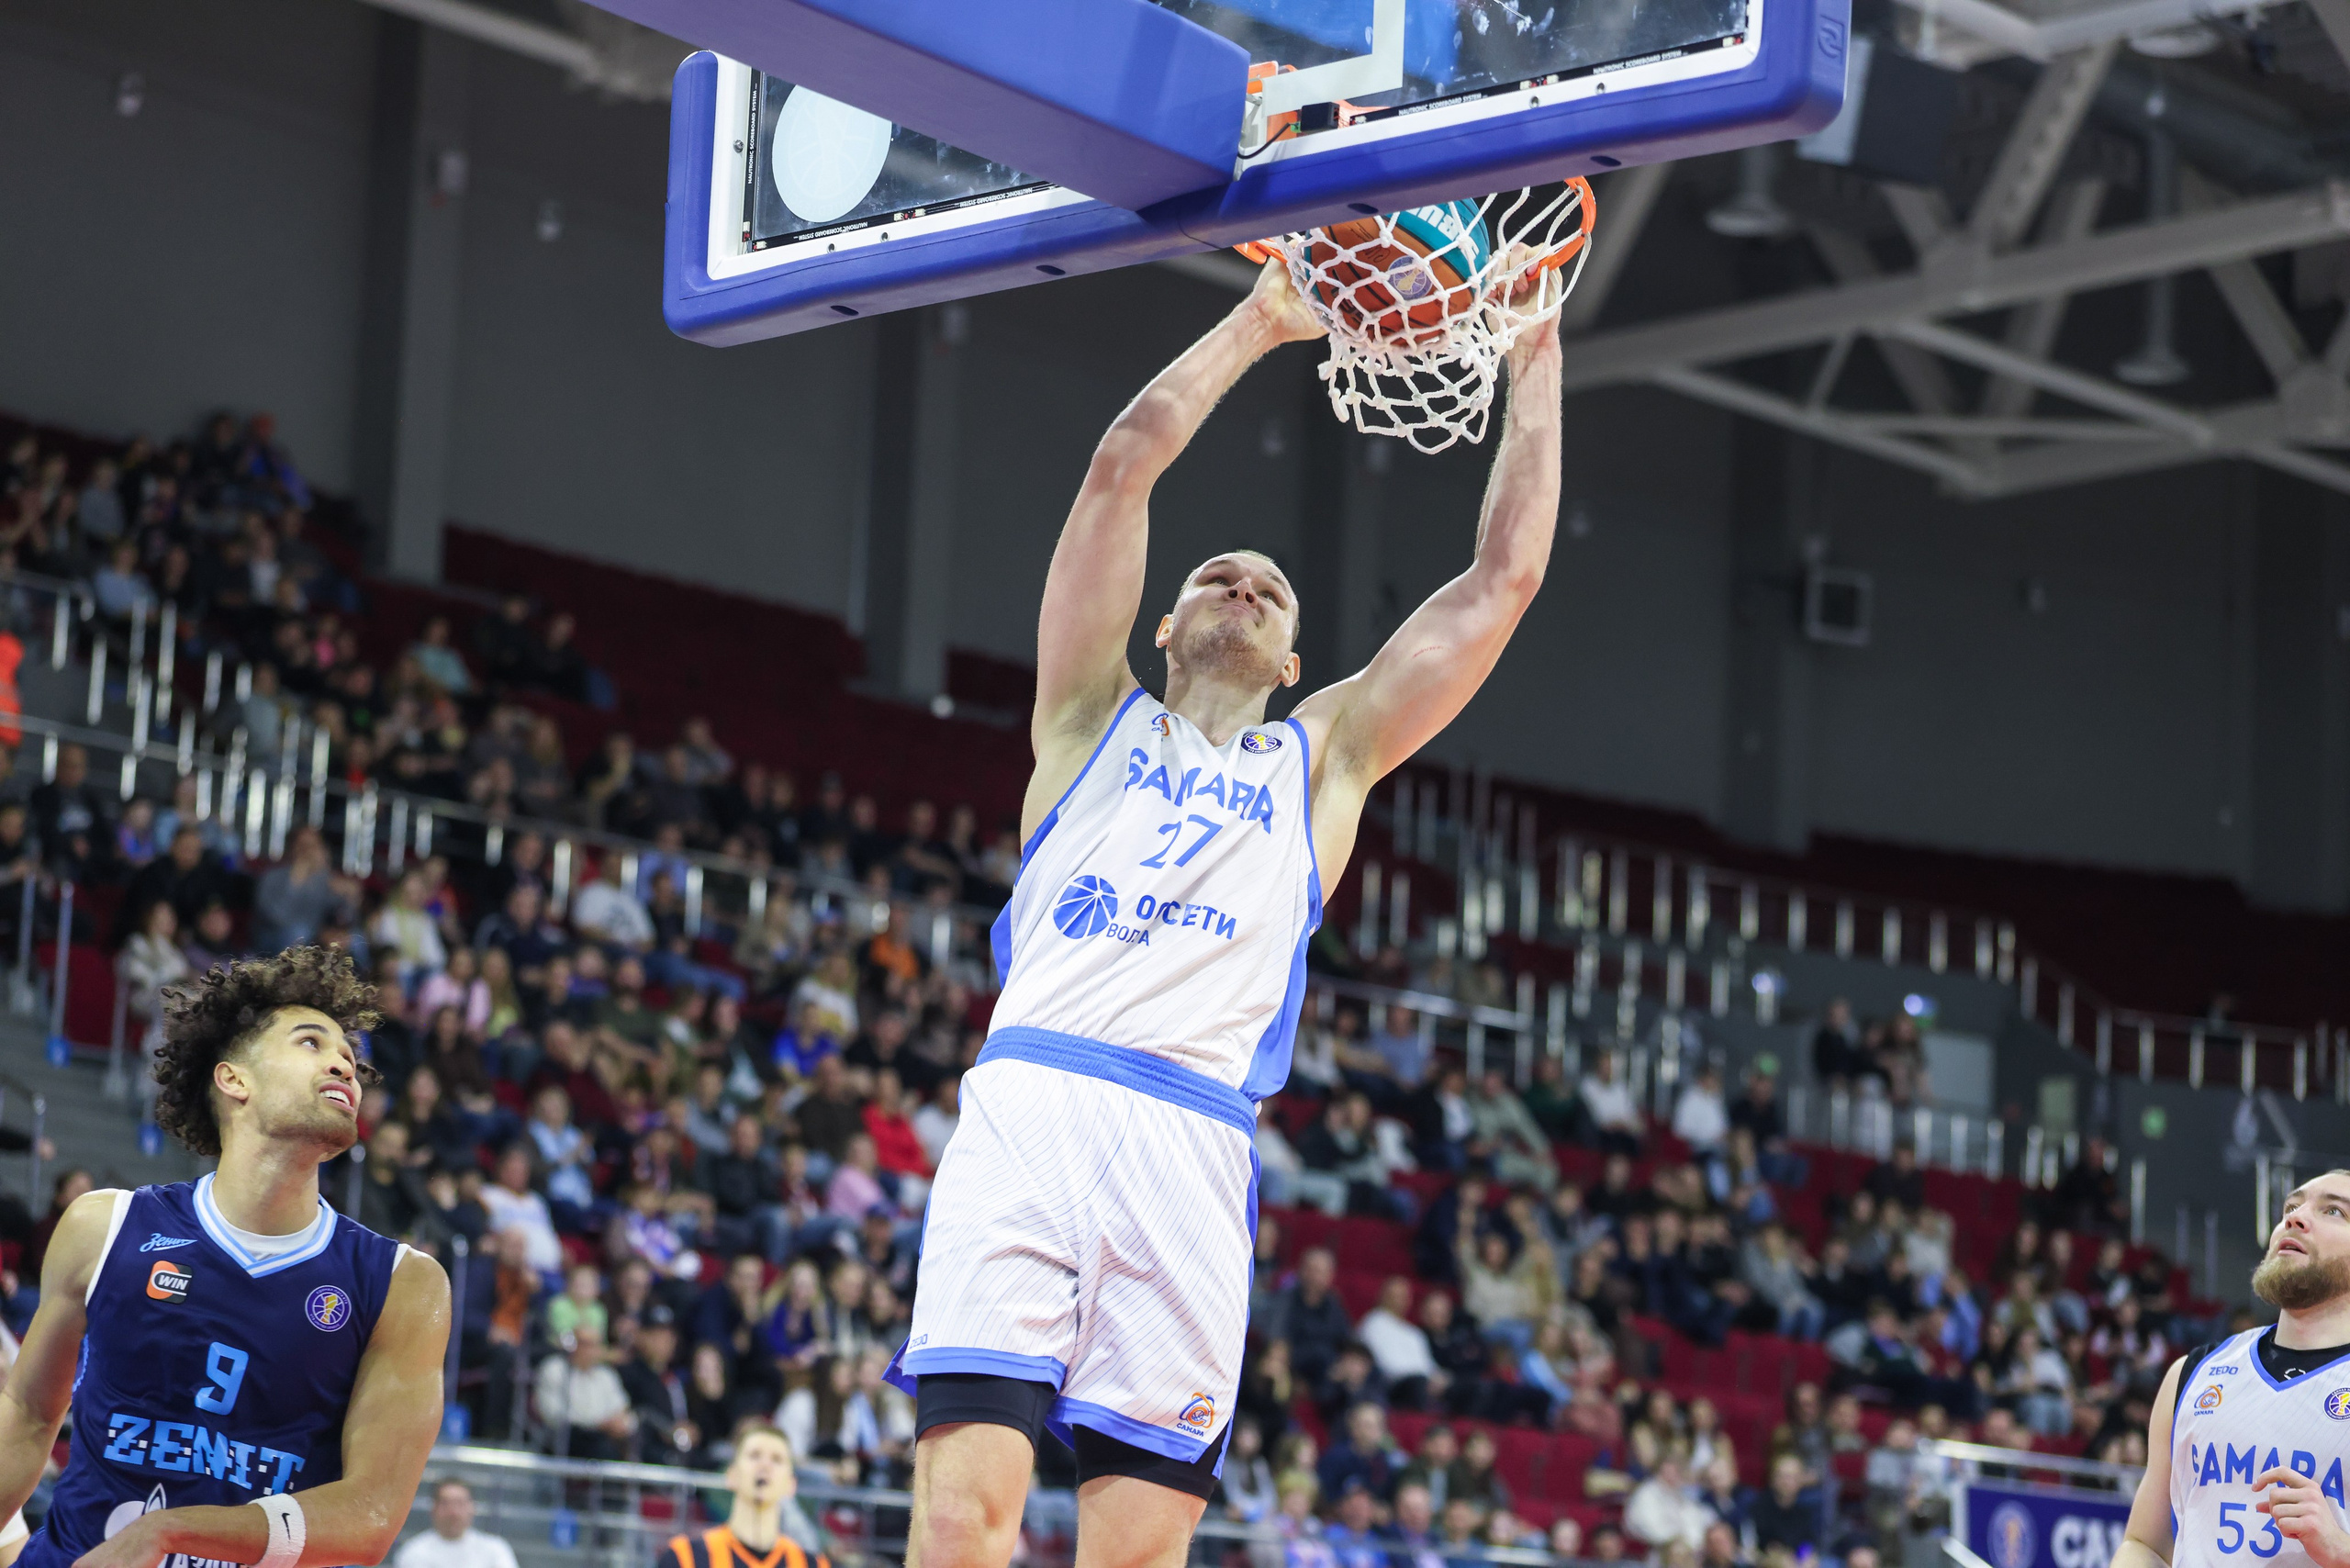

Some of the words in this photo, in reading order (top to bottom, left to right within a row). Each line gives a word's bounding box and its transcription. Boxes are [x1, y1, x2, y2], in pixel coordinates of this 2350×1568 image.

[799, 232, 814, 241] SYSTEM
[814, 227, 843, 238] SCOREBOARD
[843, 221, 868, 232] NAUTRONIC
[1125, 747, 1274, 835] SAMARA
[1138, 814, 1224, 869] 27
[158, 1274, 189, 1291] WIN
[194, 1341, 249, 1416] 9
[2209, 1365, 2239, 1376] ZEDO
[103, 1413, 306, 1495] ZENIT
[2217, 1502, 2283, 1558] 53
